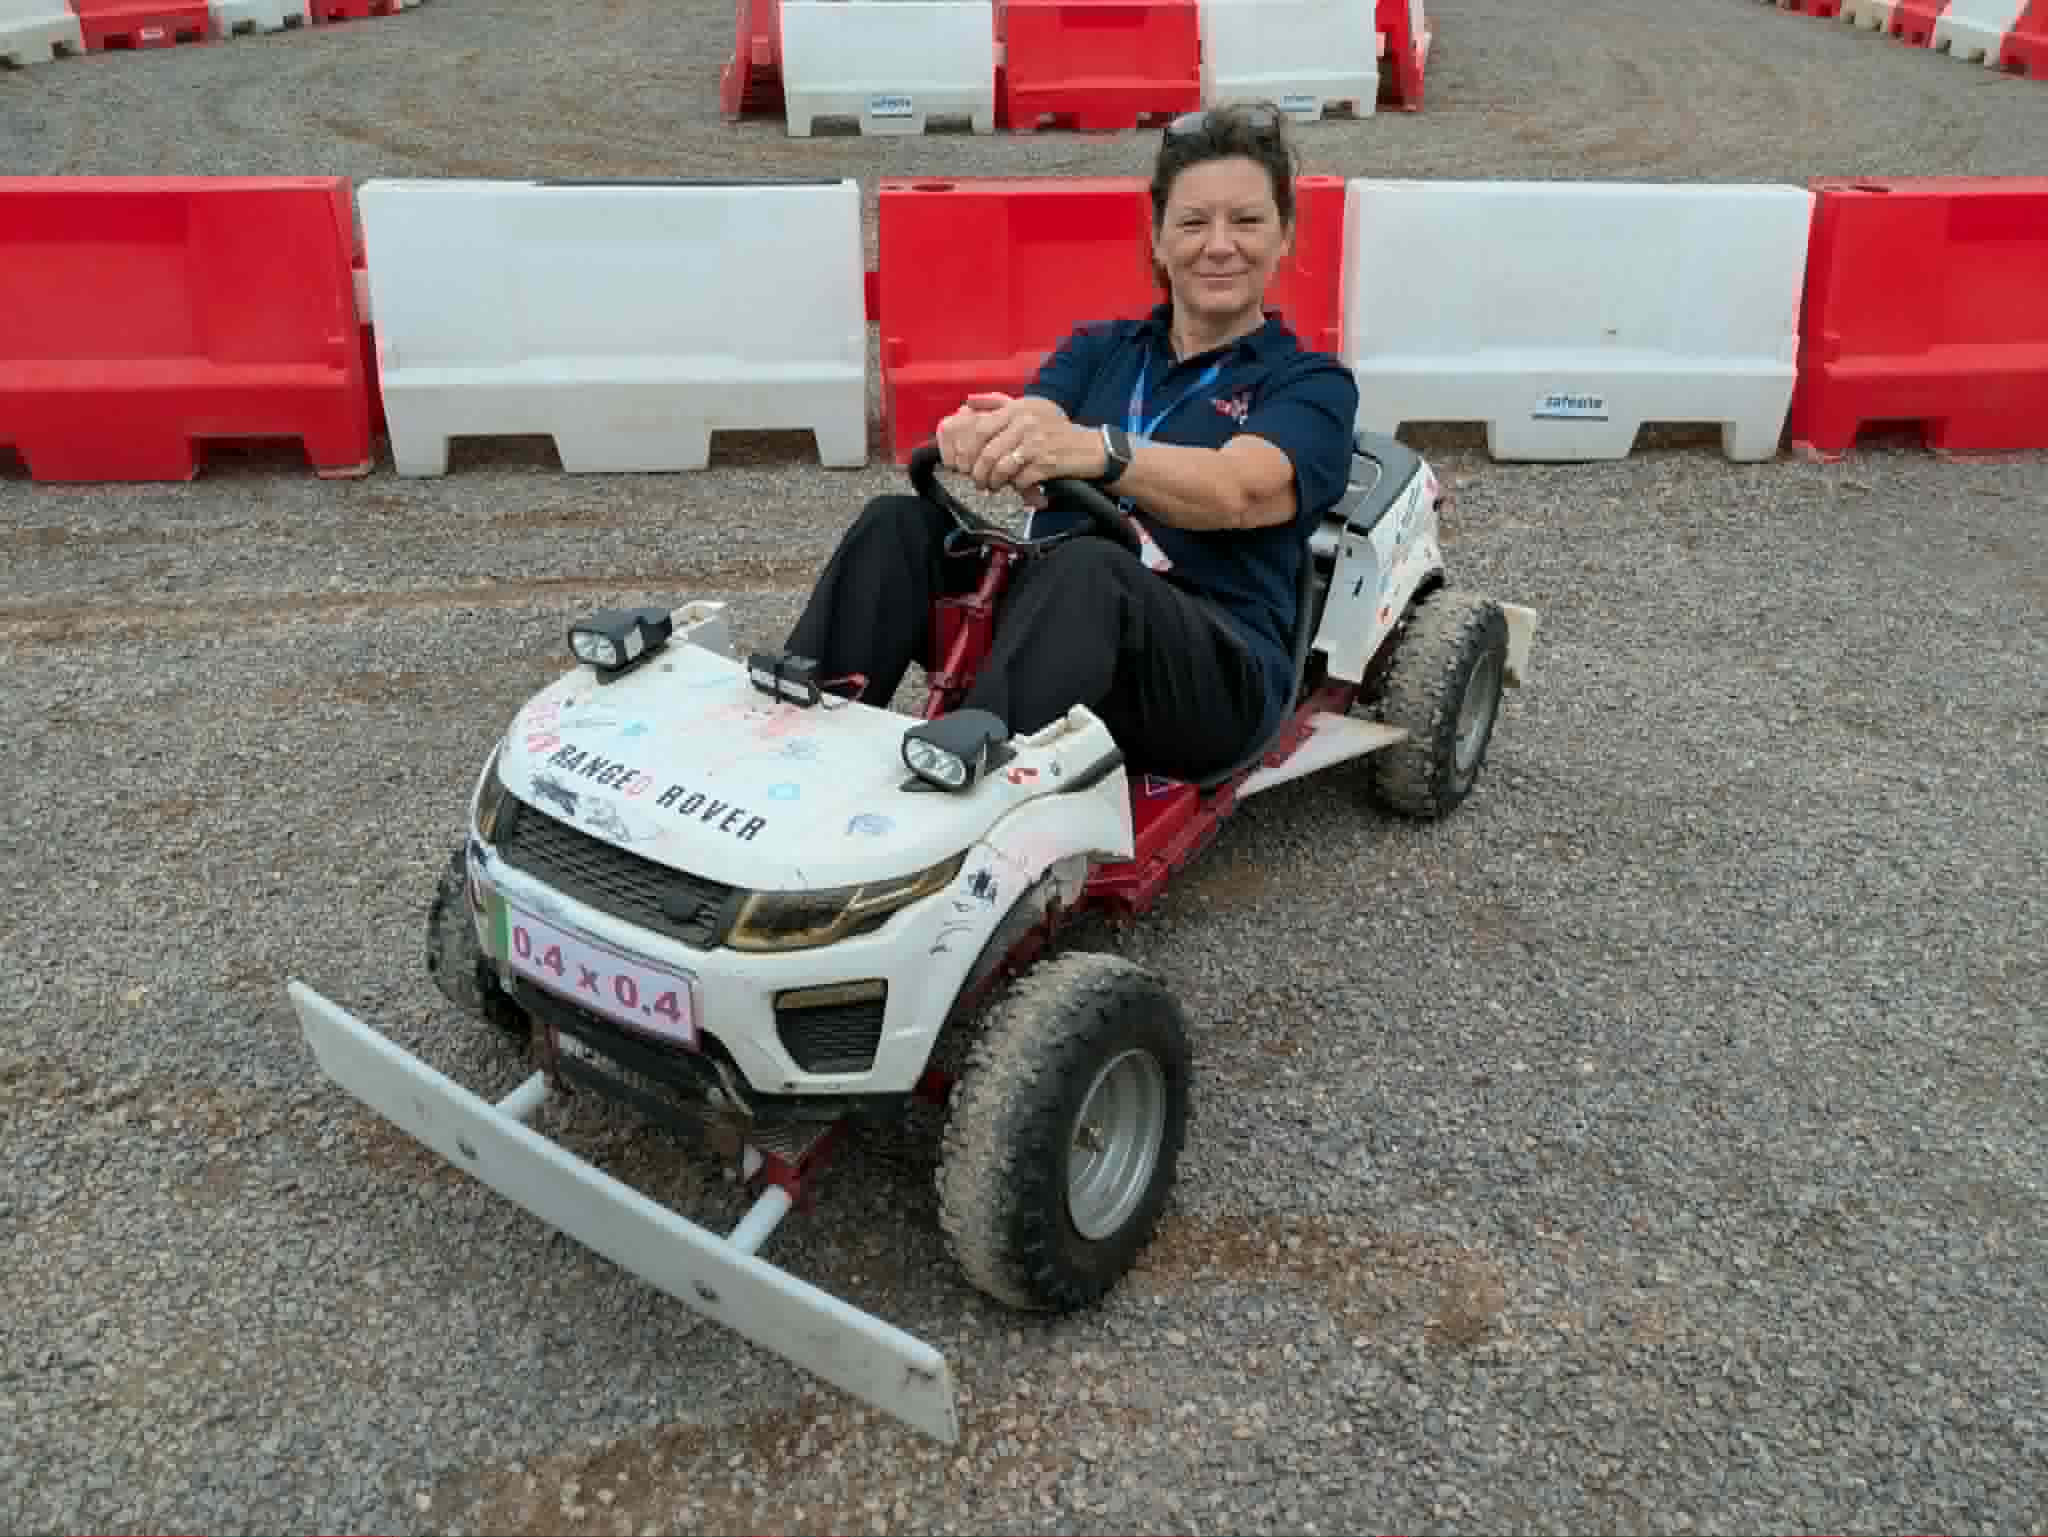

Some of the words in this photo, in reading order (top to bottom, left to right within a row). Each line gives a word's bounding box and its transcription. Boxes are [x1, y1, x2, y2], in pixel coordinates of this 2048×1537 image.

[656, 784, 767, 840] ROVER
[512, 926, 565, 977] 0.4
[576, 962, 601, 994] x
[615, 975, 682, 1022] 0.4
